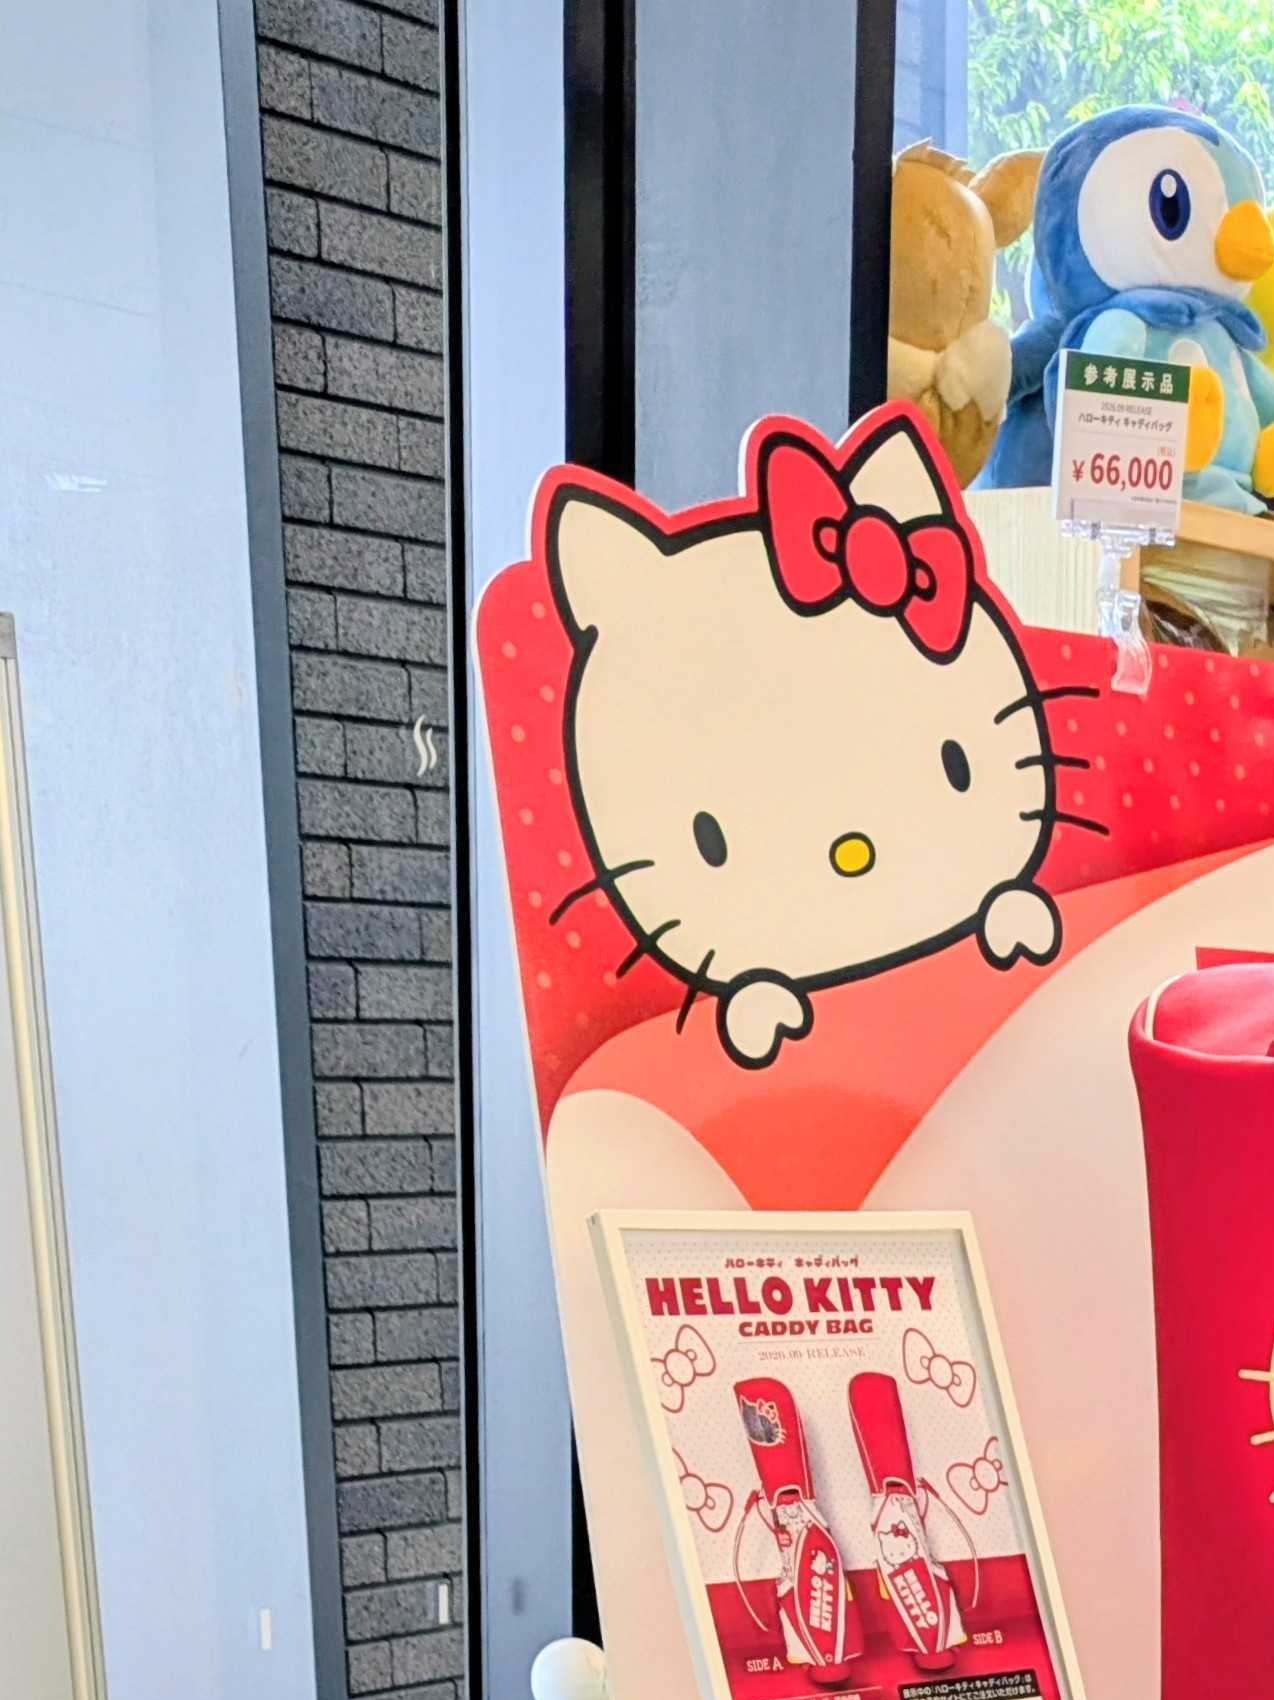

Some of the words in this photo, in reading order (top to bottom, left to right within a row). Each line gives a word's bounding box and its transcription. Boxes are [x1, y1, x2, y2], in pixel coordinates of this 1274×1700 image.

[1083, 362, 1174, 395] 参考展示品
[1078, 413, 1121, 427] ハローキティ
[1123, 417, 1173, 433] キャディバッグ
[725, 1257, 783, 1269] ハローキティ
[794, 1256, 859, 1268] キャディバッグ
[644, 1275, 793, 1316] HELLO
[803, 1275, 936, 1313] KITTY
[738, 1319, 820, 1337] CADDY
[826, 1318, 874, 1335] BAG
[973, 1630, 994, 1645] SIDE
[994, 1630, 1004, 1645] B
[746, 1657, 771, 1673] SIDE
[772, 1656, 784, 1671] A
